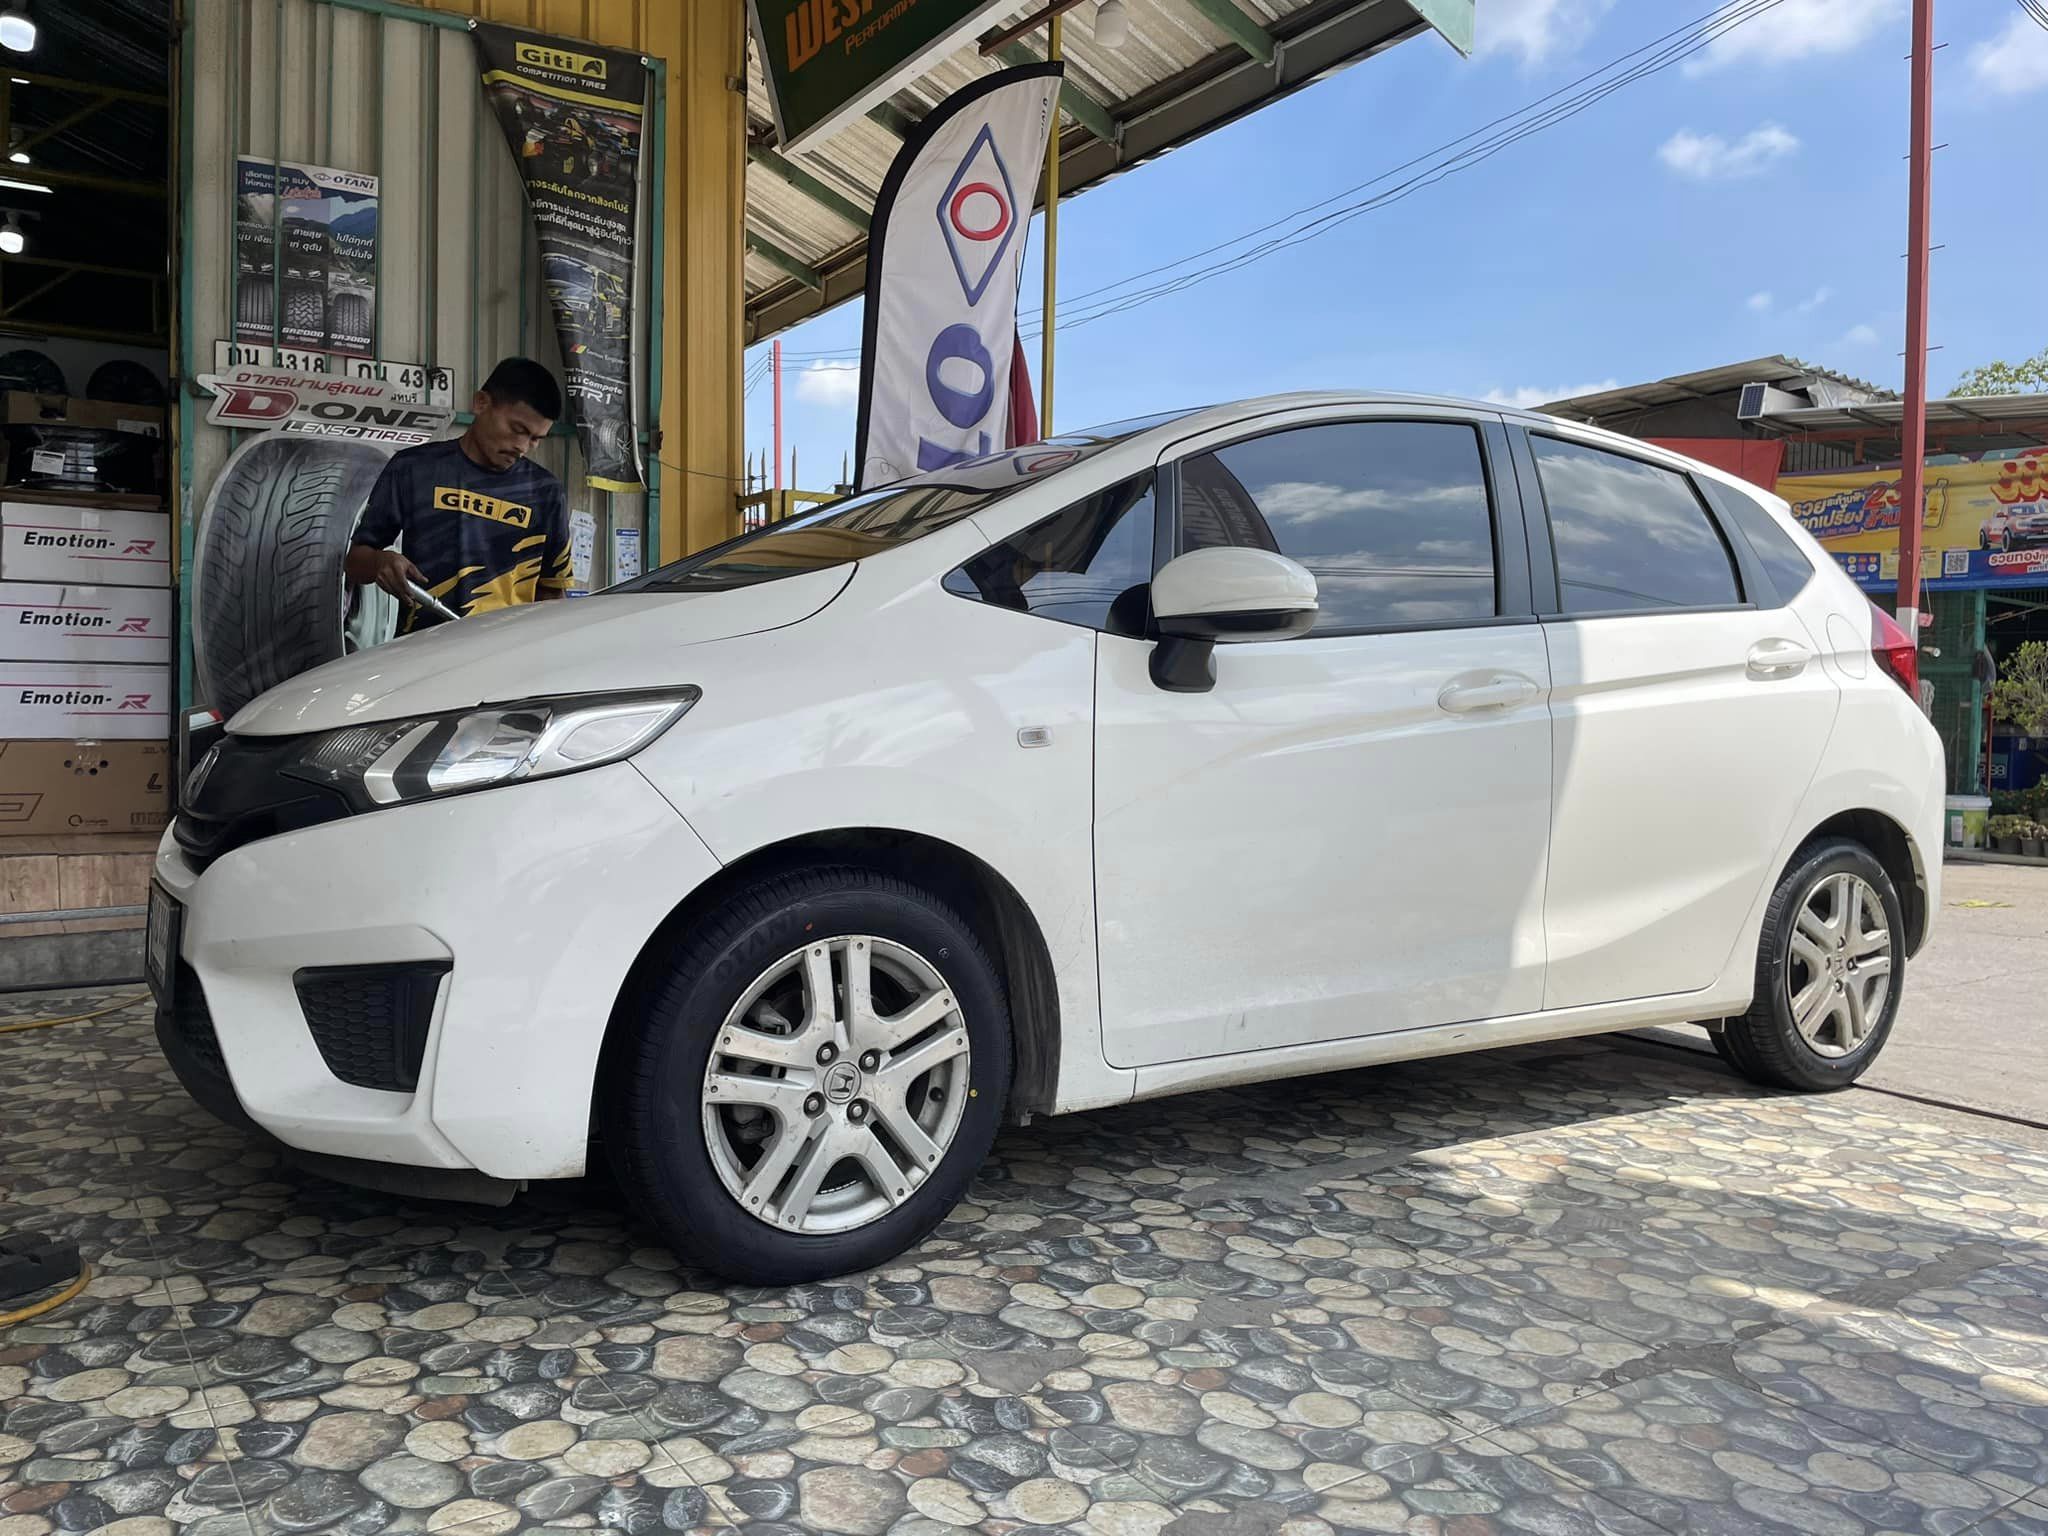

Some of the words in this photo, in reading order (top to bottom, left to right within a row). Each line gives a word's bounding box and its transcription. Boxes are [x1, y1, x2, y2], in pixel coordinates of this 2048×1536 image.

[522, 48, 574, 70] Giti
[581, 79, 607, 91] TIRES
[333, 175, 374, 190] OTANI
[582, 377, 623, 395] Compete
[285, 419, 362, 438] LENSO
[363, 428, 432, 445] TIRES
[441, 492, 494, 515] Giti
